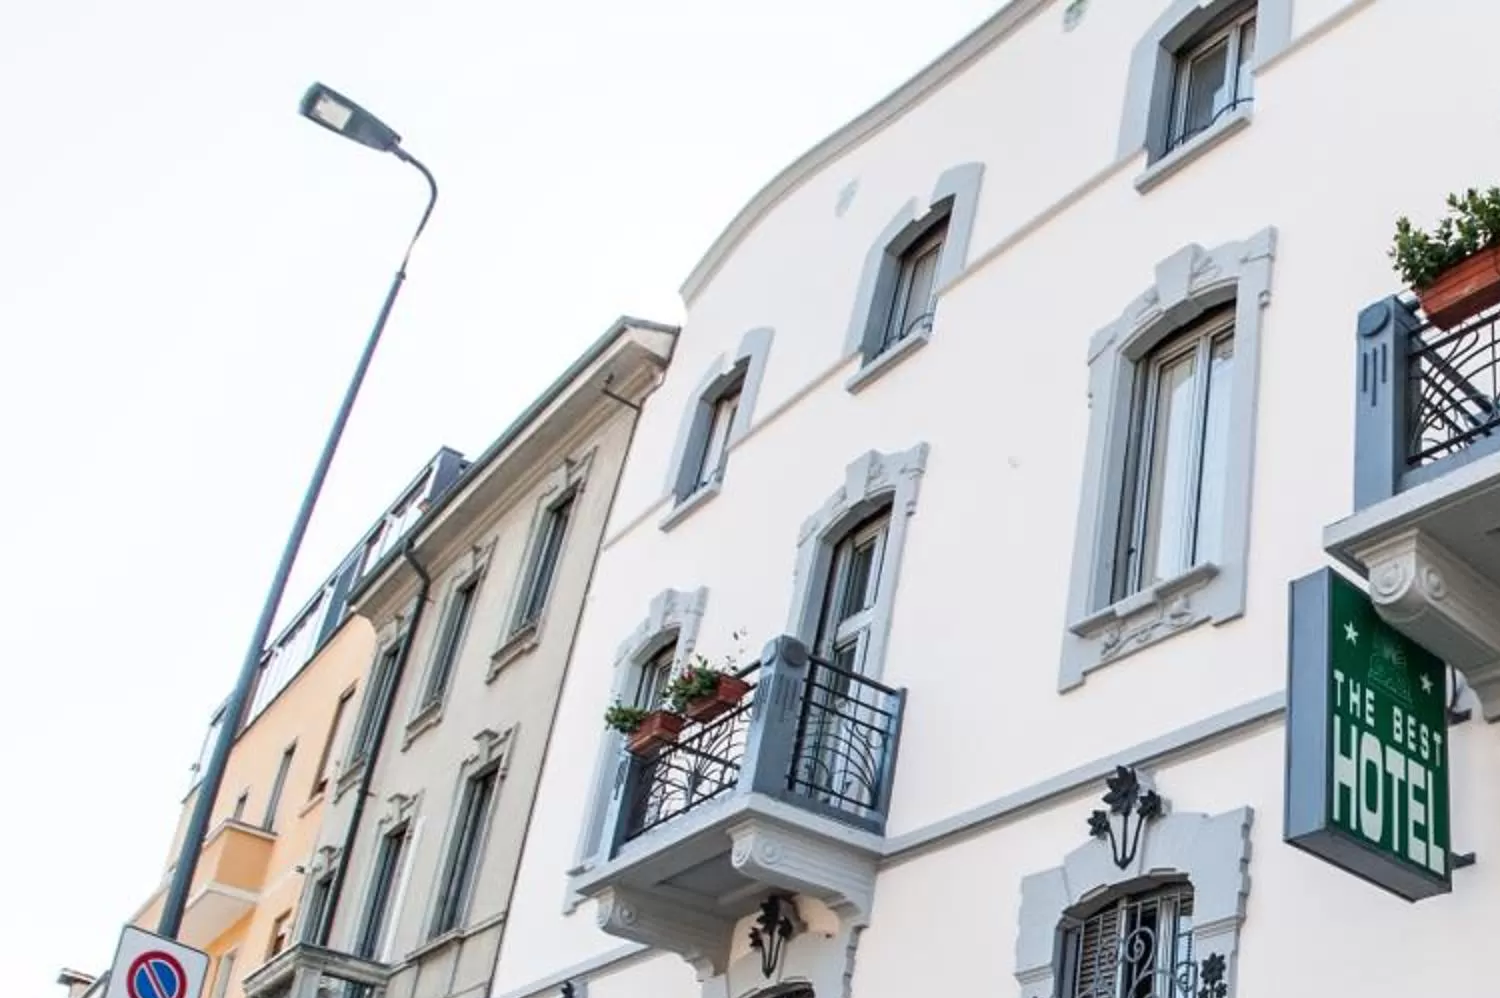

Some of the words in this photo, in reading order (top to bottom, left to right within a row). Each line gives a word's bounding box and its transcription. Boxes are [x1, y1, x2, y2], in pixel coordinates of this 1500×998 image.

[1333, 669, 1375, 728] THE
[1393, 705, 1442, 767] BEST
[1333, 714, 1445, 876] HOTEL
